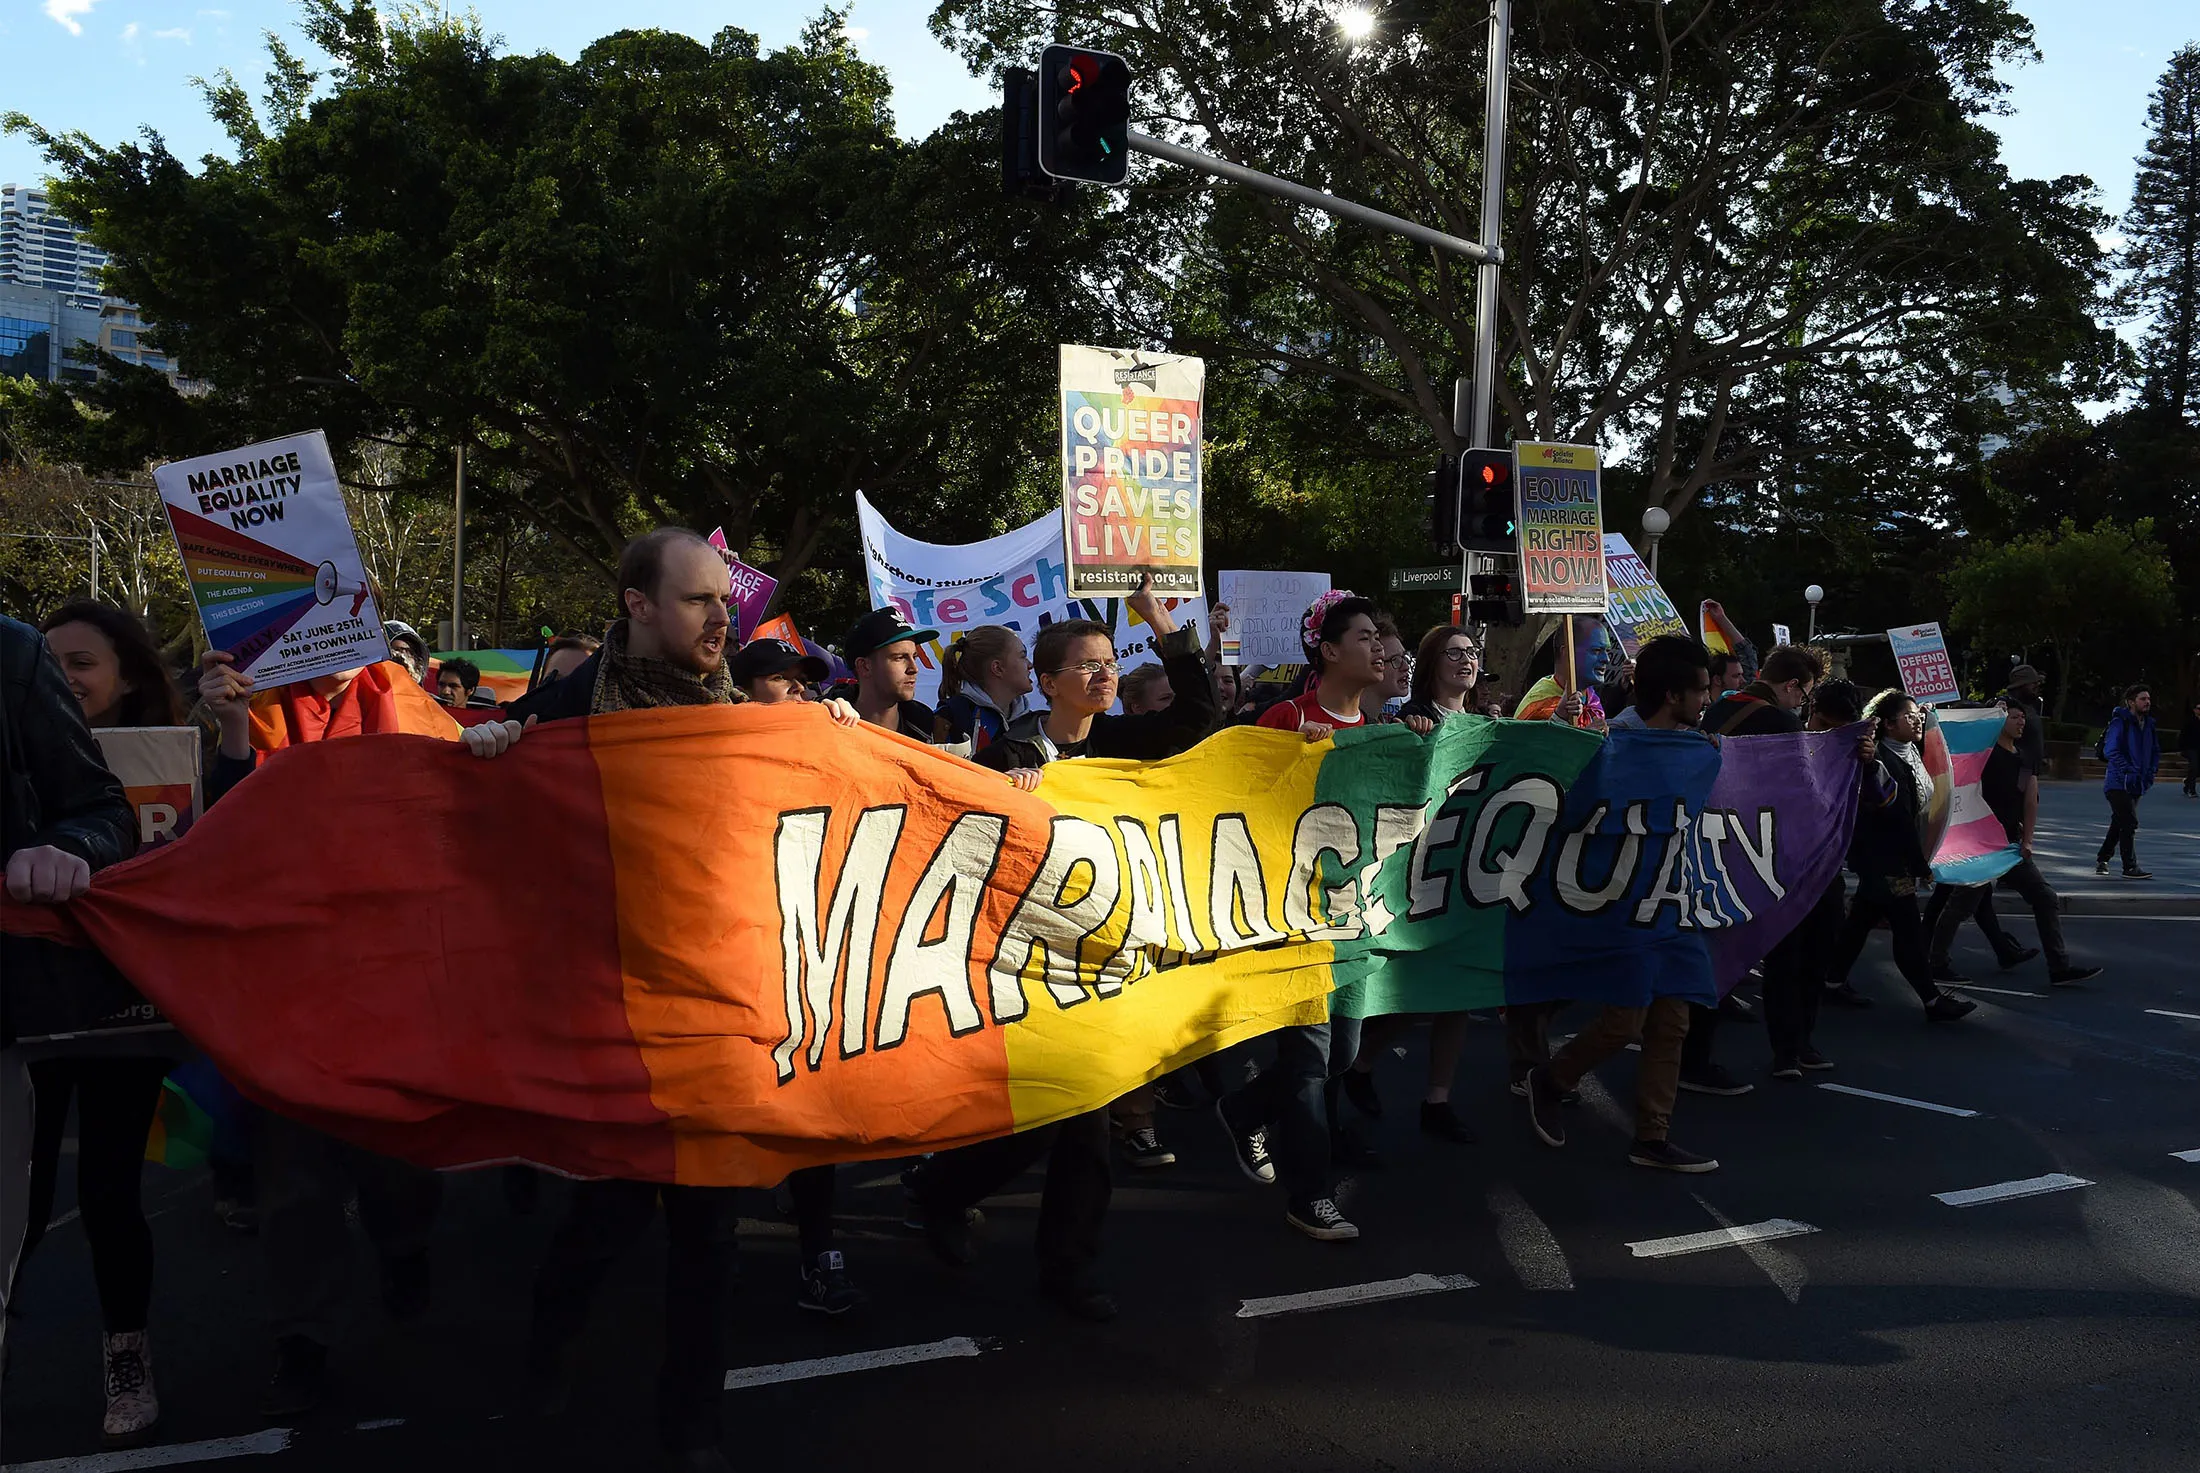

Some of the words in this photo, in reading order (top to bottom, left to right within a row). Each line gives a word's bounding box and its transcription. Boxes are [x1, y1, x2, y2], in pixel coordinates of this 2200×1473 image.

[1115, 370, 1156, 380] RESISTANCE
[1073, 406, 1192, 445] QUEER
[187, 452, 301, 494] MARRIAGE
[1075, 445, 1192, 482] PRIDE
[197, 474, 301, 515] EQUALITY
[1525, 476, 1595, 505] EQUAL
[1076, 484, 1192, 520] SAVES
[230, 501, 284, 531] NOW
[1527, 508, 1596, 525] MARRIAGE
[1079, 523, 1193, 558] LIVES
[1528, 528, 1598, 552] RIGHTS
[183, 542, 204, 554] SAFE
[206, 546, 247, 562] SCHOOLS
[197, 567, 213, 576] PUT
[213, 569, 253, 579] EQUALITY
[253, 572, 267, 580] ON
[1081, 569, 1193, 587] resistanc.org.au
[1403, 569, 1442, 584] Liverpool
[1443, 569, 1452, 580] St
[1529, 556, 1600, 586] NOW!
[206, 589, 222, 598] THE
[222, 586, 253, 597] AGENDA
[210, 609, 229, 620] THIS
[228, 600, 265, 615] ELECTION
[282, 631, 303, 644] SAT
[305, 624, 335, 639] JUNE
[337, 617, 364, 632] 25TH
[279, 646, 303, 659] 1PM
[302, 644, 312, 653] @
[312, 636, 348, 651] TOWN
[348, 629, 377, 644] HALL
[257, 662, 287, 674] COMMUNITY
[287, 660, 305, 668] ACTION
[1900, 652, 1946, 667] DEFEND
[1904, 664, 1951, 685] SAFE
[1908, 681, 1954, 695] SCHOOLS
